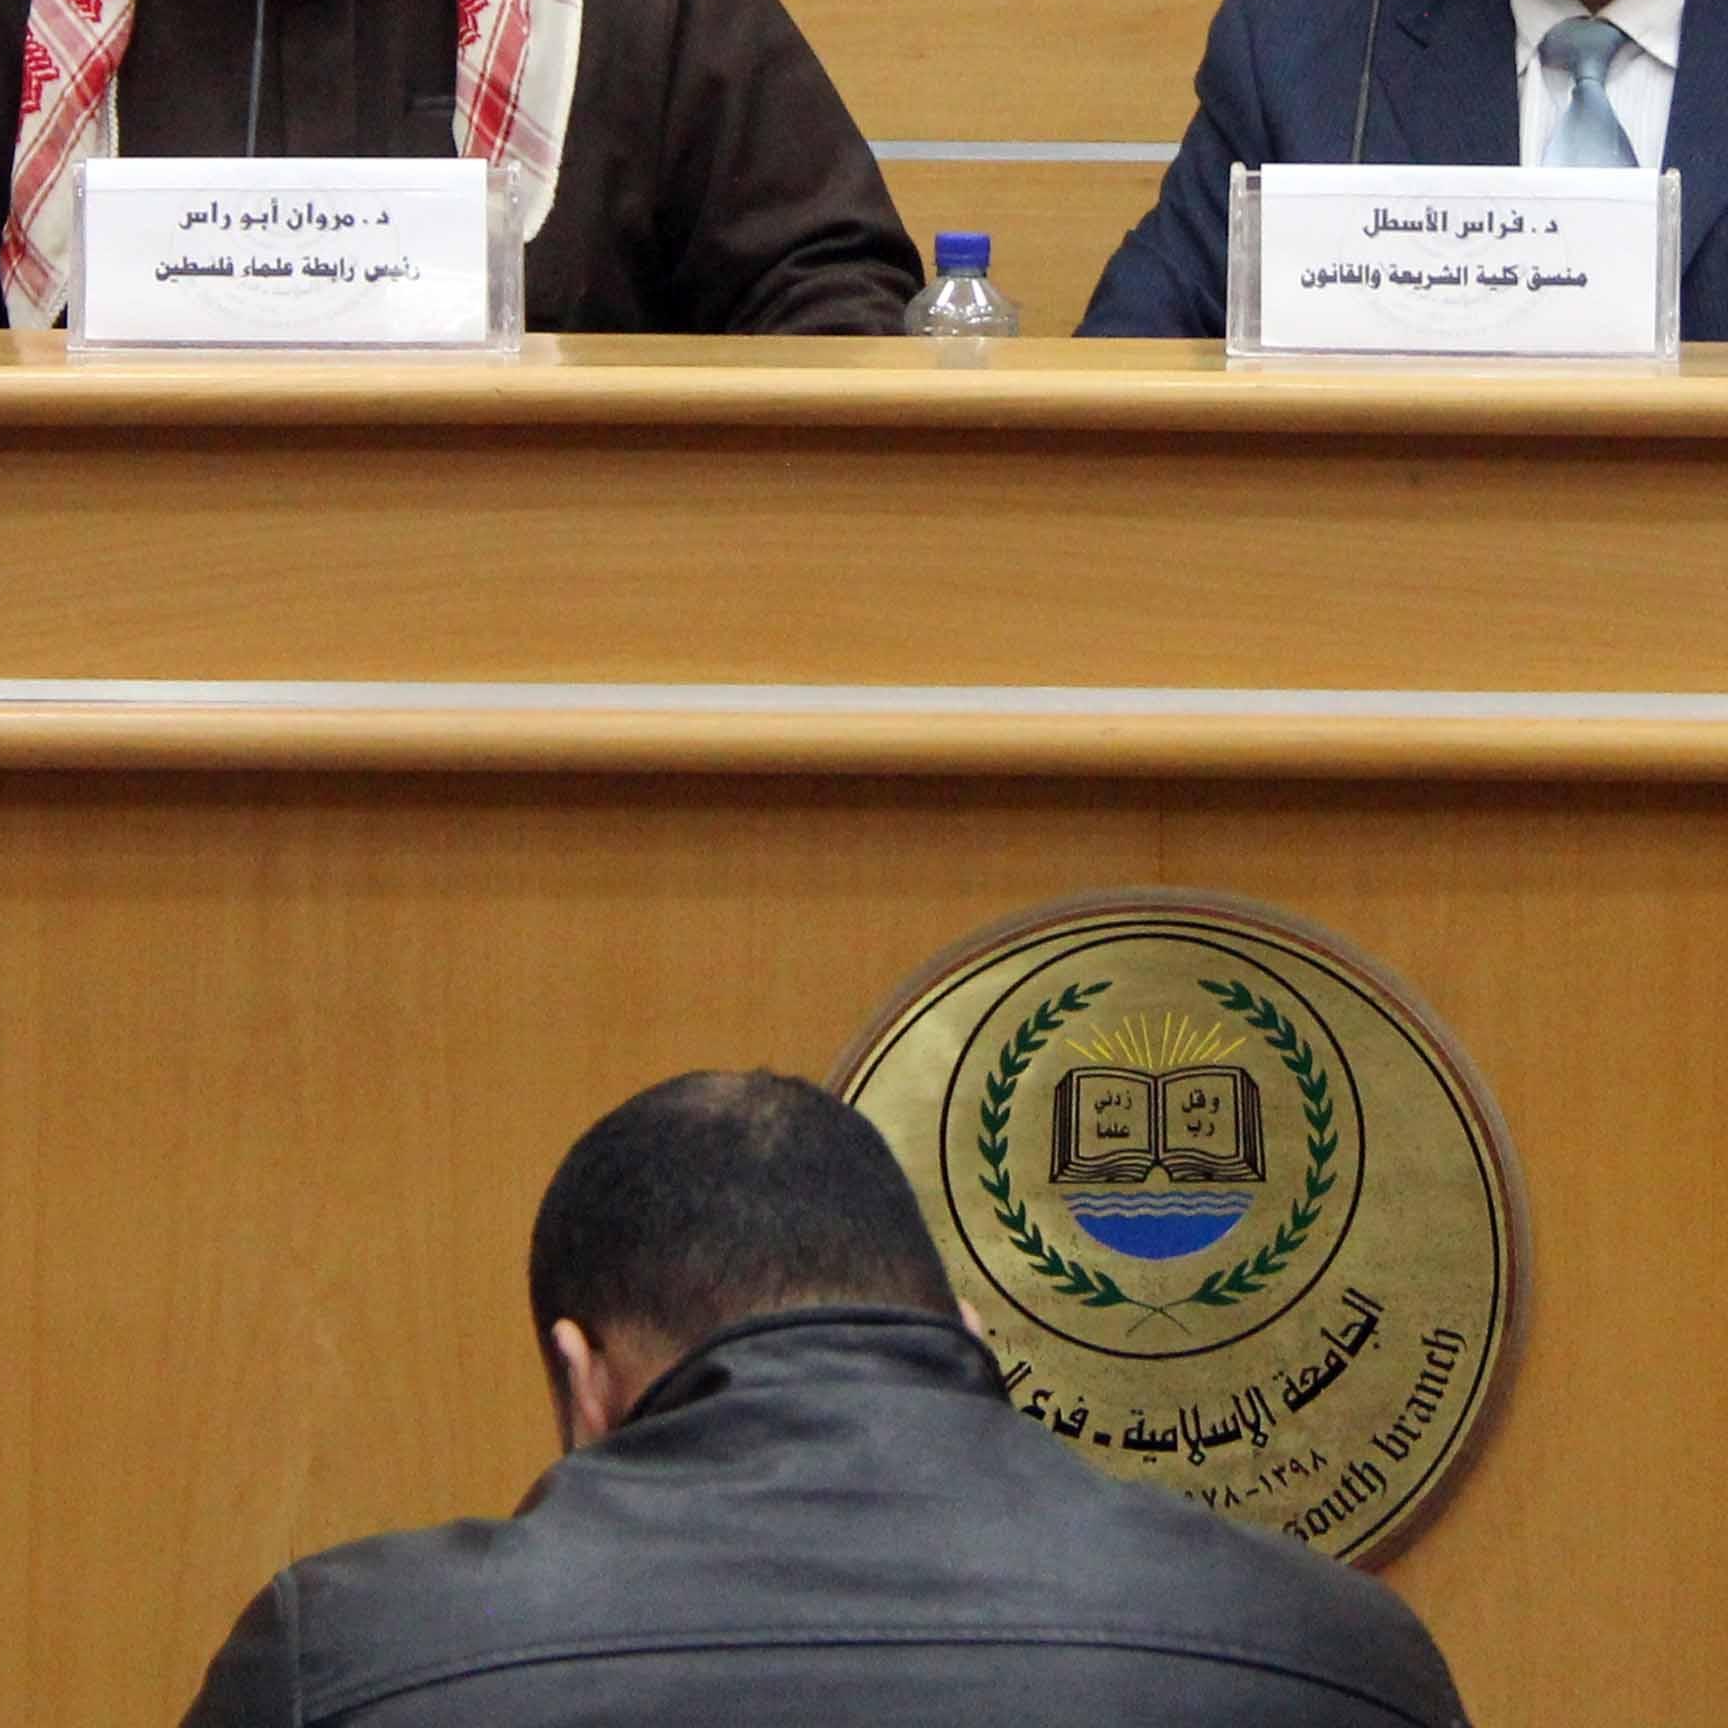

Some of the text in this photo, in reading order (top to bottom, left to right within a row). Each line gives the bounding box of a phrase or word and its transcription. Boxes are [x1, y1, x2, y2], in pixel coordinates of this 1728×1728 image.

[179, 202, 231, 229] راس
[240, 198, 278, 230] أبو
[285, 202, 355, 230] مروان
[1363, 208, 1447, 237] الأسطل
[1456, 208, 1524, 238] فراس
[155, 255, 421, 282] رئيس رابطة علماء فلسطين
[1300, 264, 1588, 291] منسق كلية الشريعة والقانون
[1094, 1090, 1133, 1115] زدني
[1181, 1088, 1220, 1114] وقل
[1096, 1121, 1130, 1138] علما
[1187, 1119, 1215, 1137] رب
[1272, 1287, 1384, 1413] الجامعة
[1371, 1327, 1468, 1462] branch
